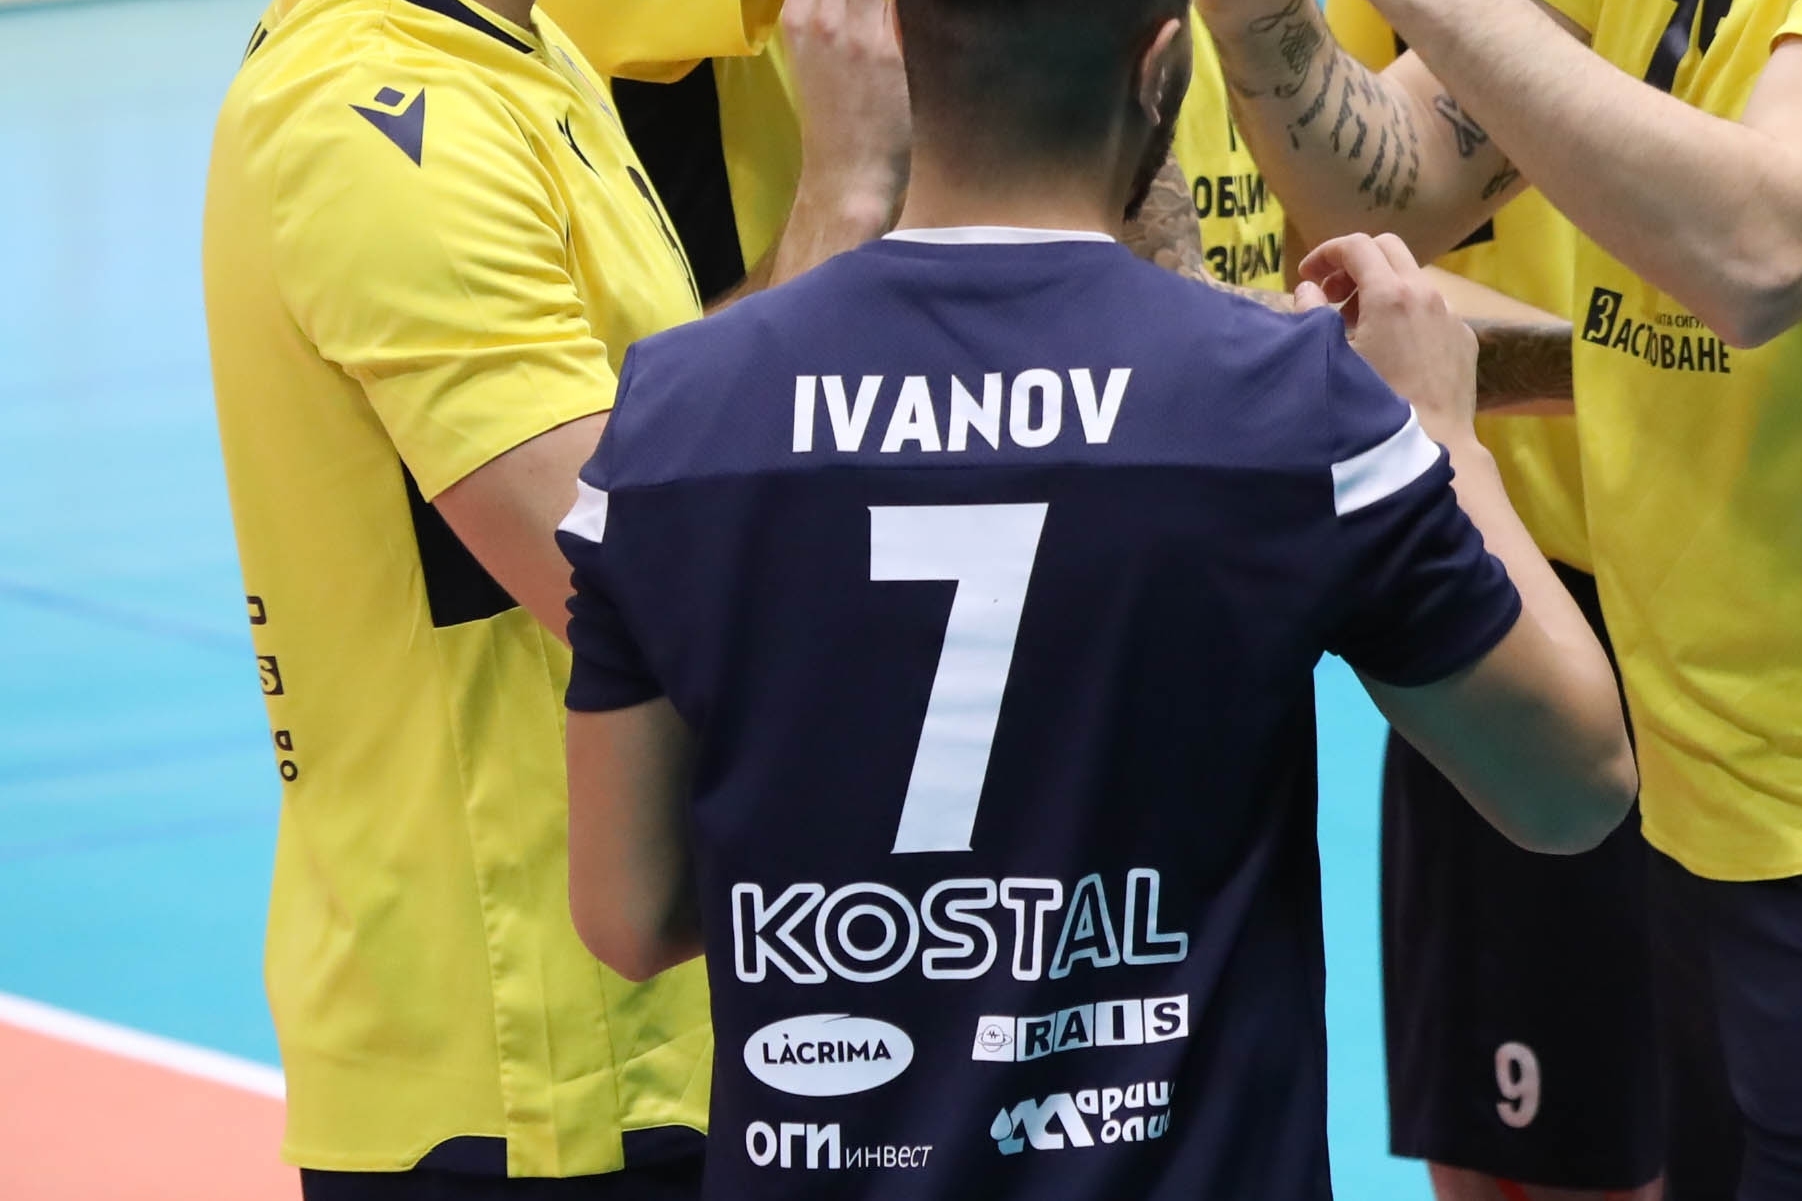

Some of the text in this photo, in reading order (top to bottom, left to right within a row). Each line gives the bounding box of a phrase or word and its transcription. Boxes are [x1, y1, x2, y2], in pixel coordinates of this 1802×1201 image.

[792, 367, 1132, 453] IVANOV
[867, 502, 1050, 855] 7
[731, 867, 1189, 984] KOSTAL
[762, 1033, 892, 1066] LÀCRIMA
[1022, 1000, 1184, 1058] RAIS
[1495, 1041, 1541, 1128] 9
